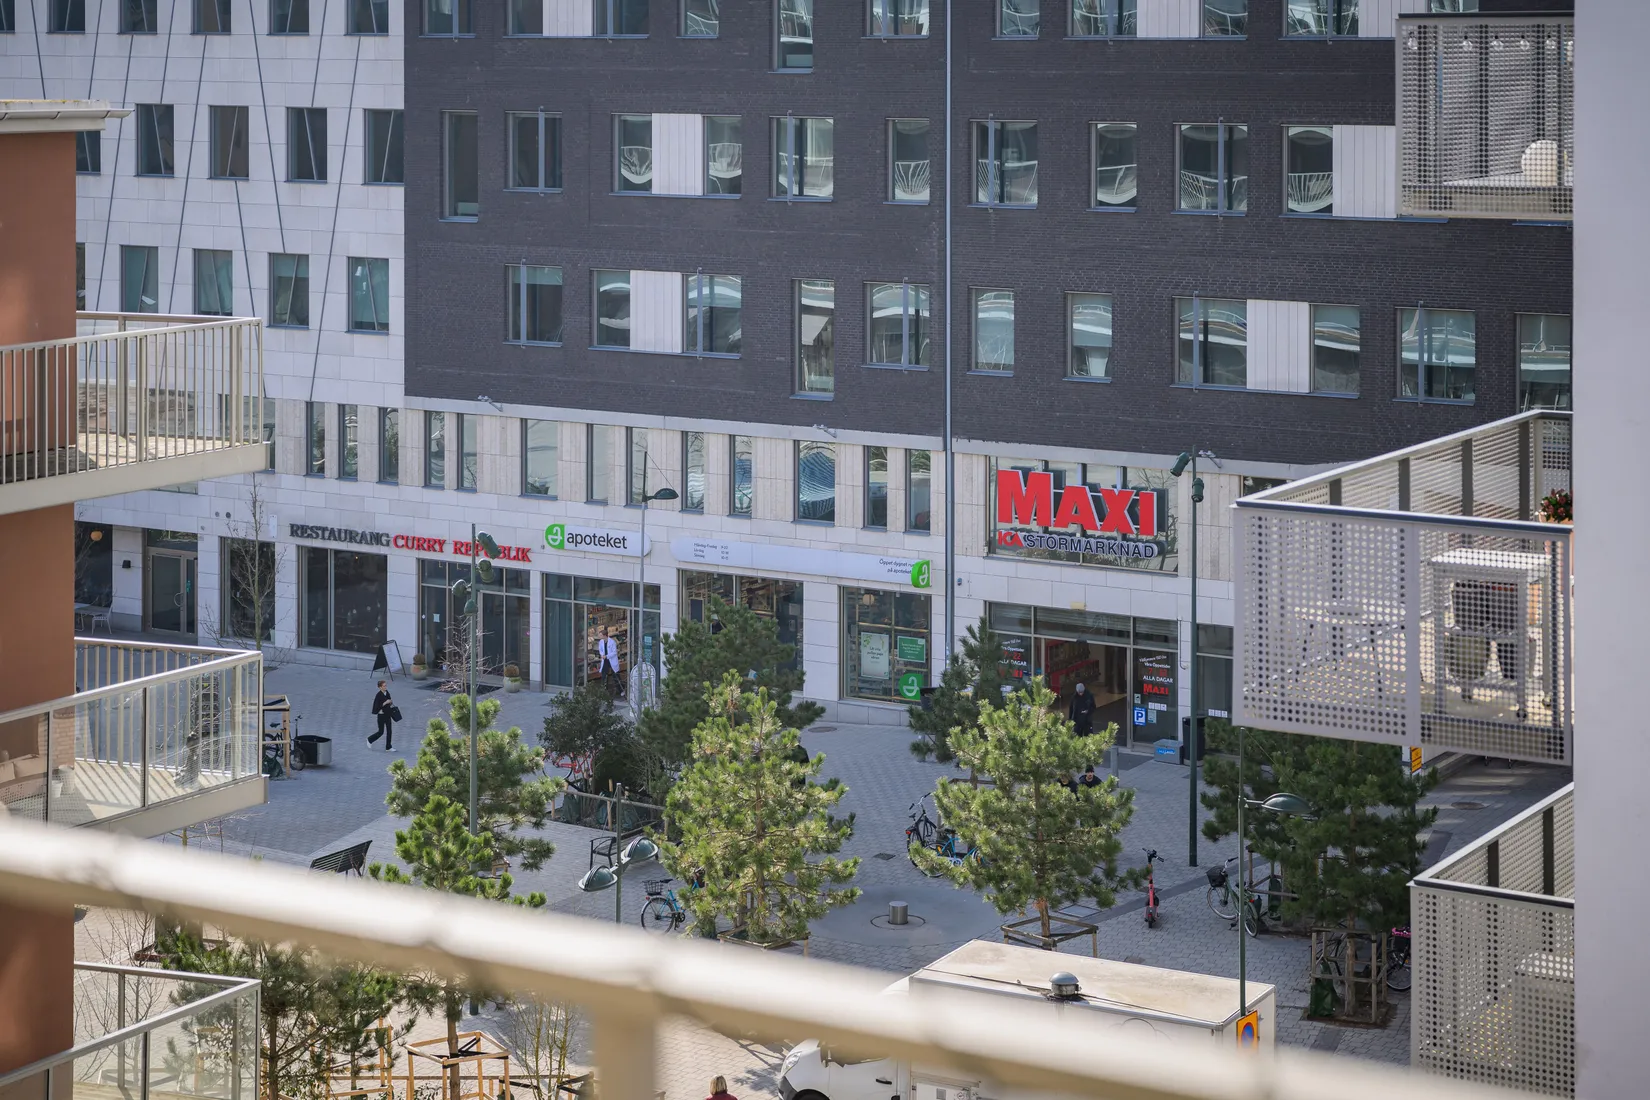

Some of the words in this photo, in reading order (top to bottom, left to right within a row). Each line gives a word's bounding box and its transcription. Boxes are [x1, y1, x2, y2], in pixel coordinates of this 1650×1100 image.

[998, 469, 1156, 536] MAXI
[289, 523, 390, 547] RESTAURANG
[392, 534, 446, 554] CURRY
[567, 532, 628, 549] apoteket
[998, 530, 1023, 547] ICA
[1025, 535, 1154, 558] STORMARKNAD
[1143, 683, 1169, 695] MAXI
[1156, 676, 1174, 684] DAGAR
